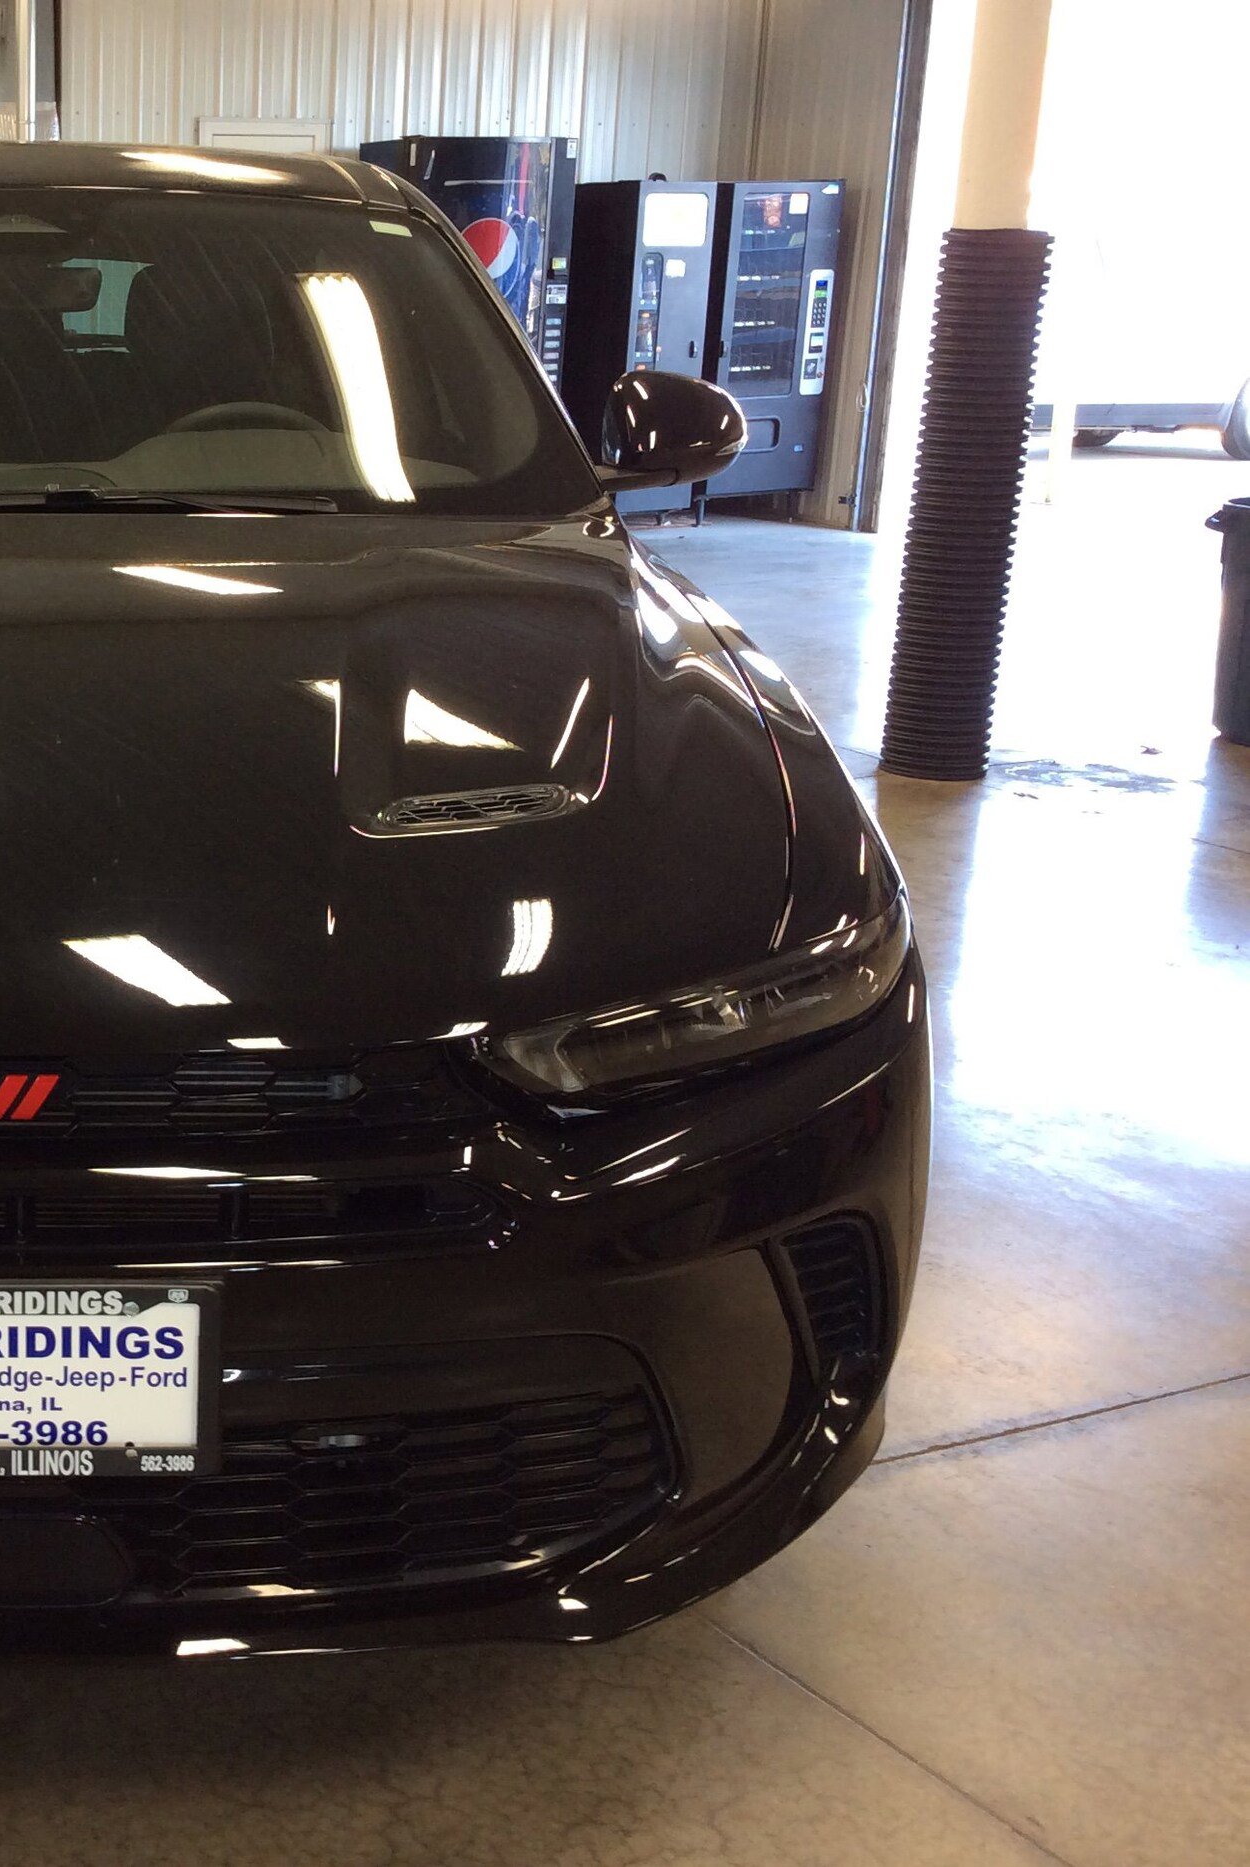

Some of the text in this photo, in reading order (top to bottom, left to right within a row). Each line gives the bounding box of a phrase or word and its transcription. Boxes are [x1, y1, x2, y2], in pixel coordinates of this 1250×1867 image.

[41, 1396, 63, 1412] IL
[11, 1450, 94, 1476] ILLINOIS
[140, 1454, 196, 1473] 562-3986
